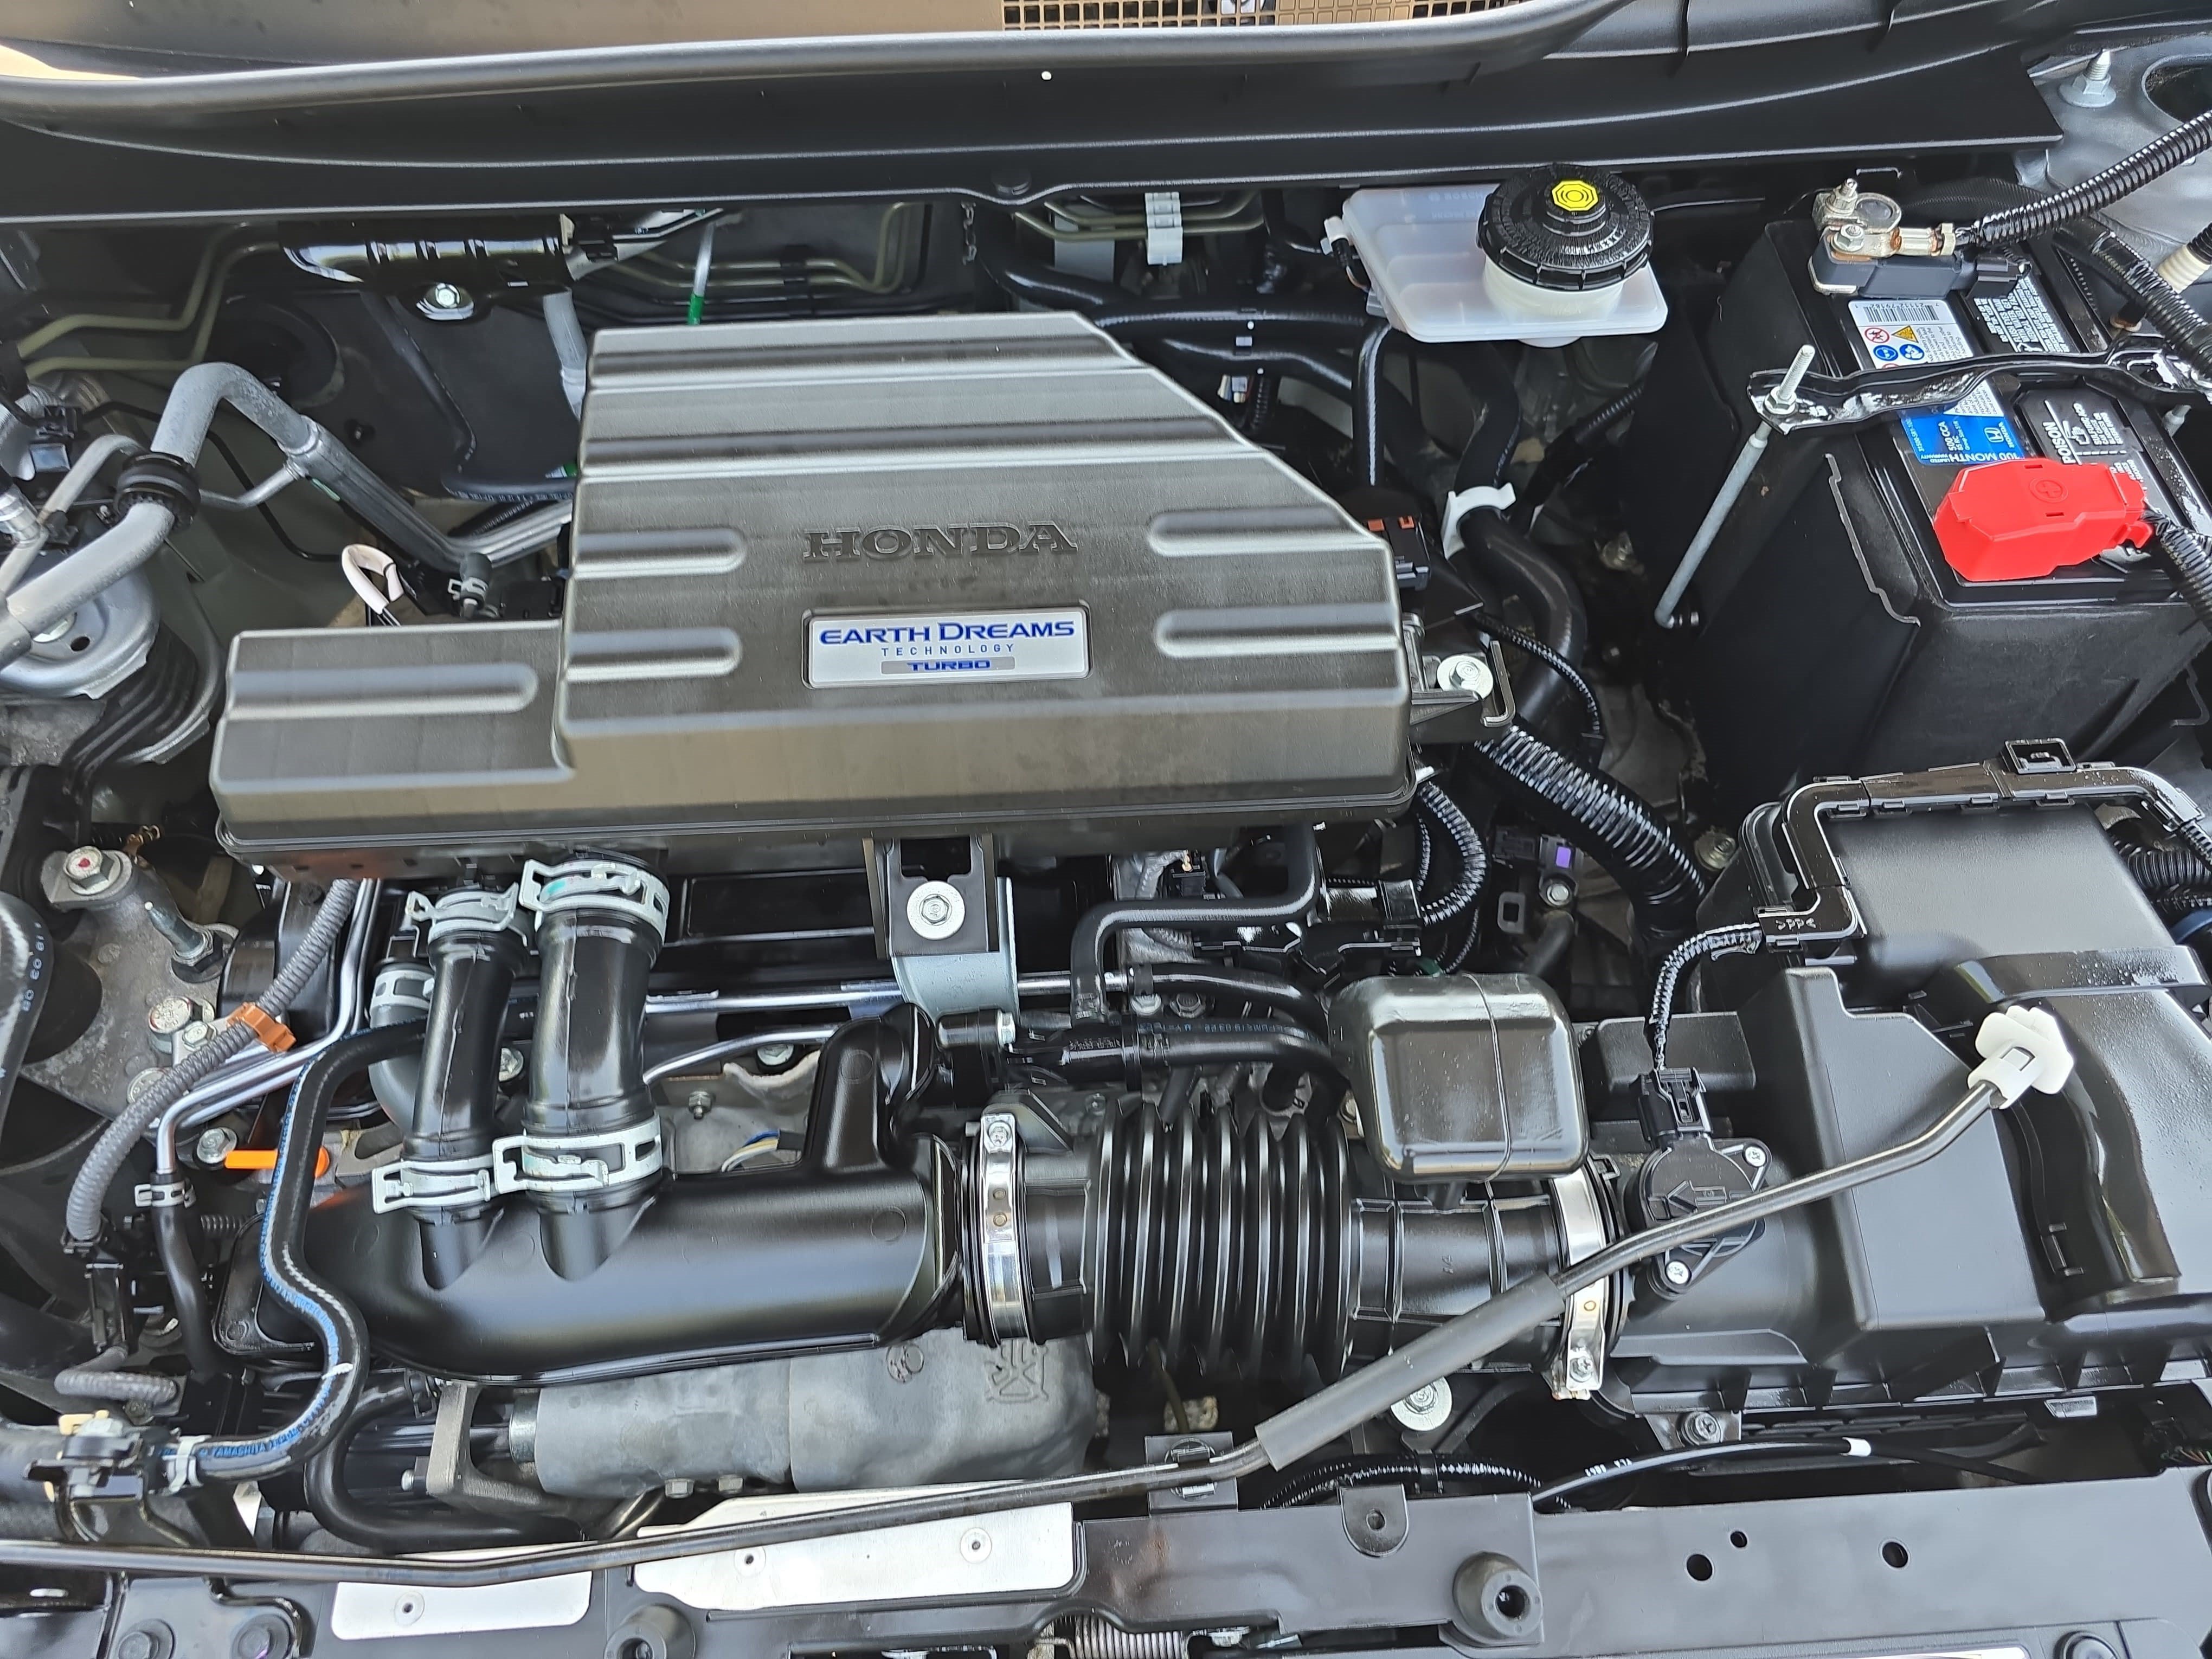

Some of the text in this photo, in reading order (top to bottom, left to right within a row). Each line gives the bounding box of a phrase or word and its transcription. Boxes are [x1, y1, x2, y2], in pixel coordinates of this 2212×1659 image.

[2001, 298, 2012, 309] GET
[2012, 305, 2027, 319] HELP
[1999, 311, 2013, 325] EYES
[2006, 325, 2023, 342] FLUSH
[2016, 329, 2030, 342] WITH
[2020, 320, 2039, 342] MEDICAL
[1931, 338, 1942, 351] known
[1937, 421, 1957, 451] 500 CCA
[1997, 422, 2015, 447] HONDA
[2080, 417, 2103, 445] SULFURIC
[2089, 419, 2110, 444] CAN CAUSE
[2097, 421, 2116, 444] BLINDNESS
[2109, 428, 2124, 443] SEVERE
[2042, 421, 2076, 463] POISON
[1949, 452, 2019, 462] 100 MONTH
[803, 520, 1079, 562] HONDA
[819, 621, 1075, 645] EARTH DREAMS
[881, 644, 1015, 657] TECHNOLOGY
[906, 659, 991, 671] TURBO
